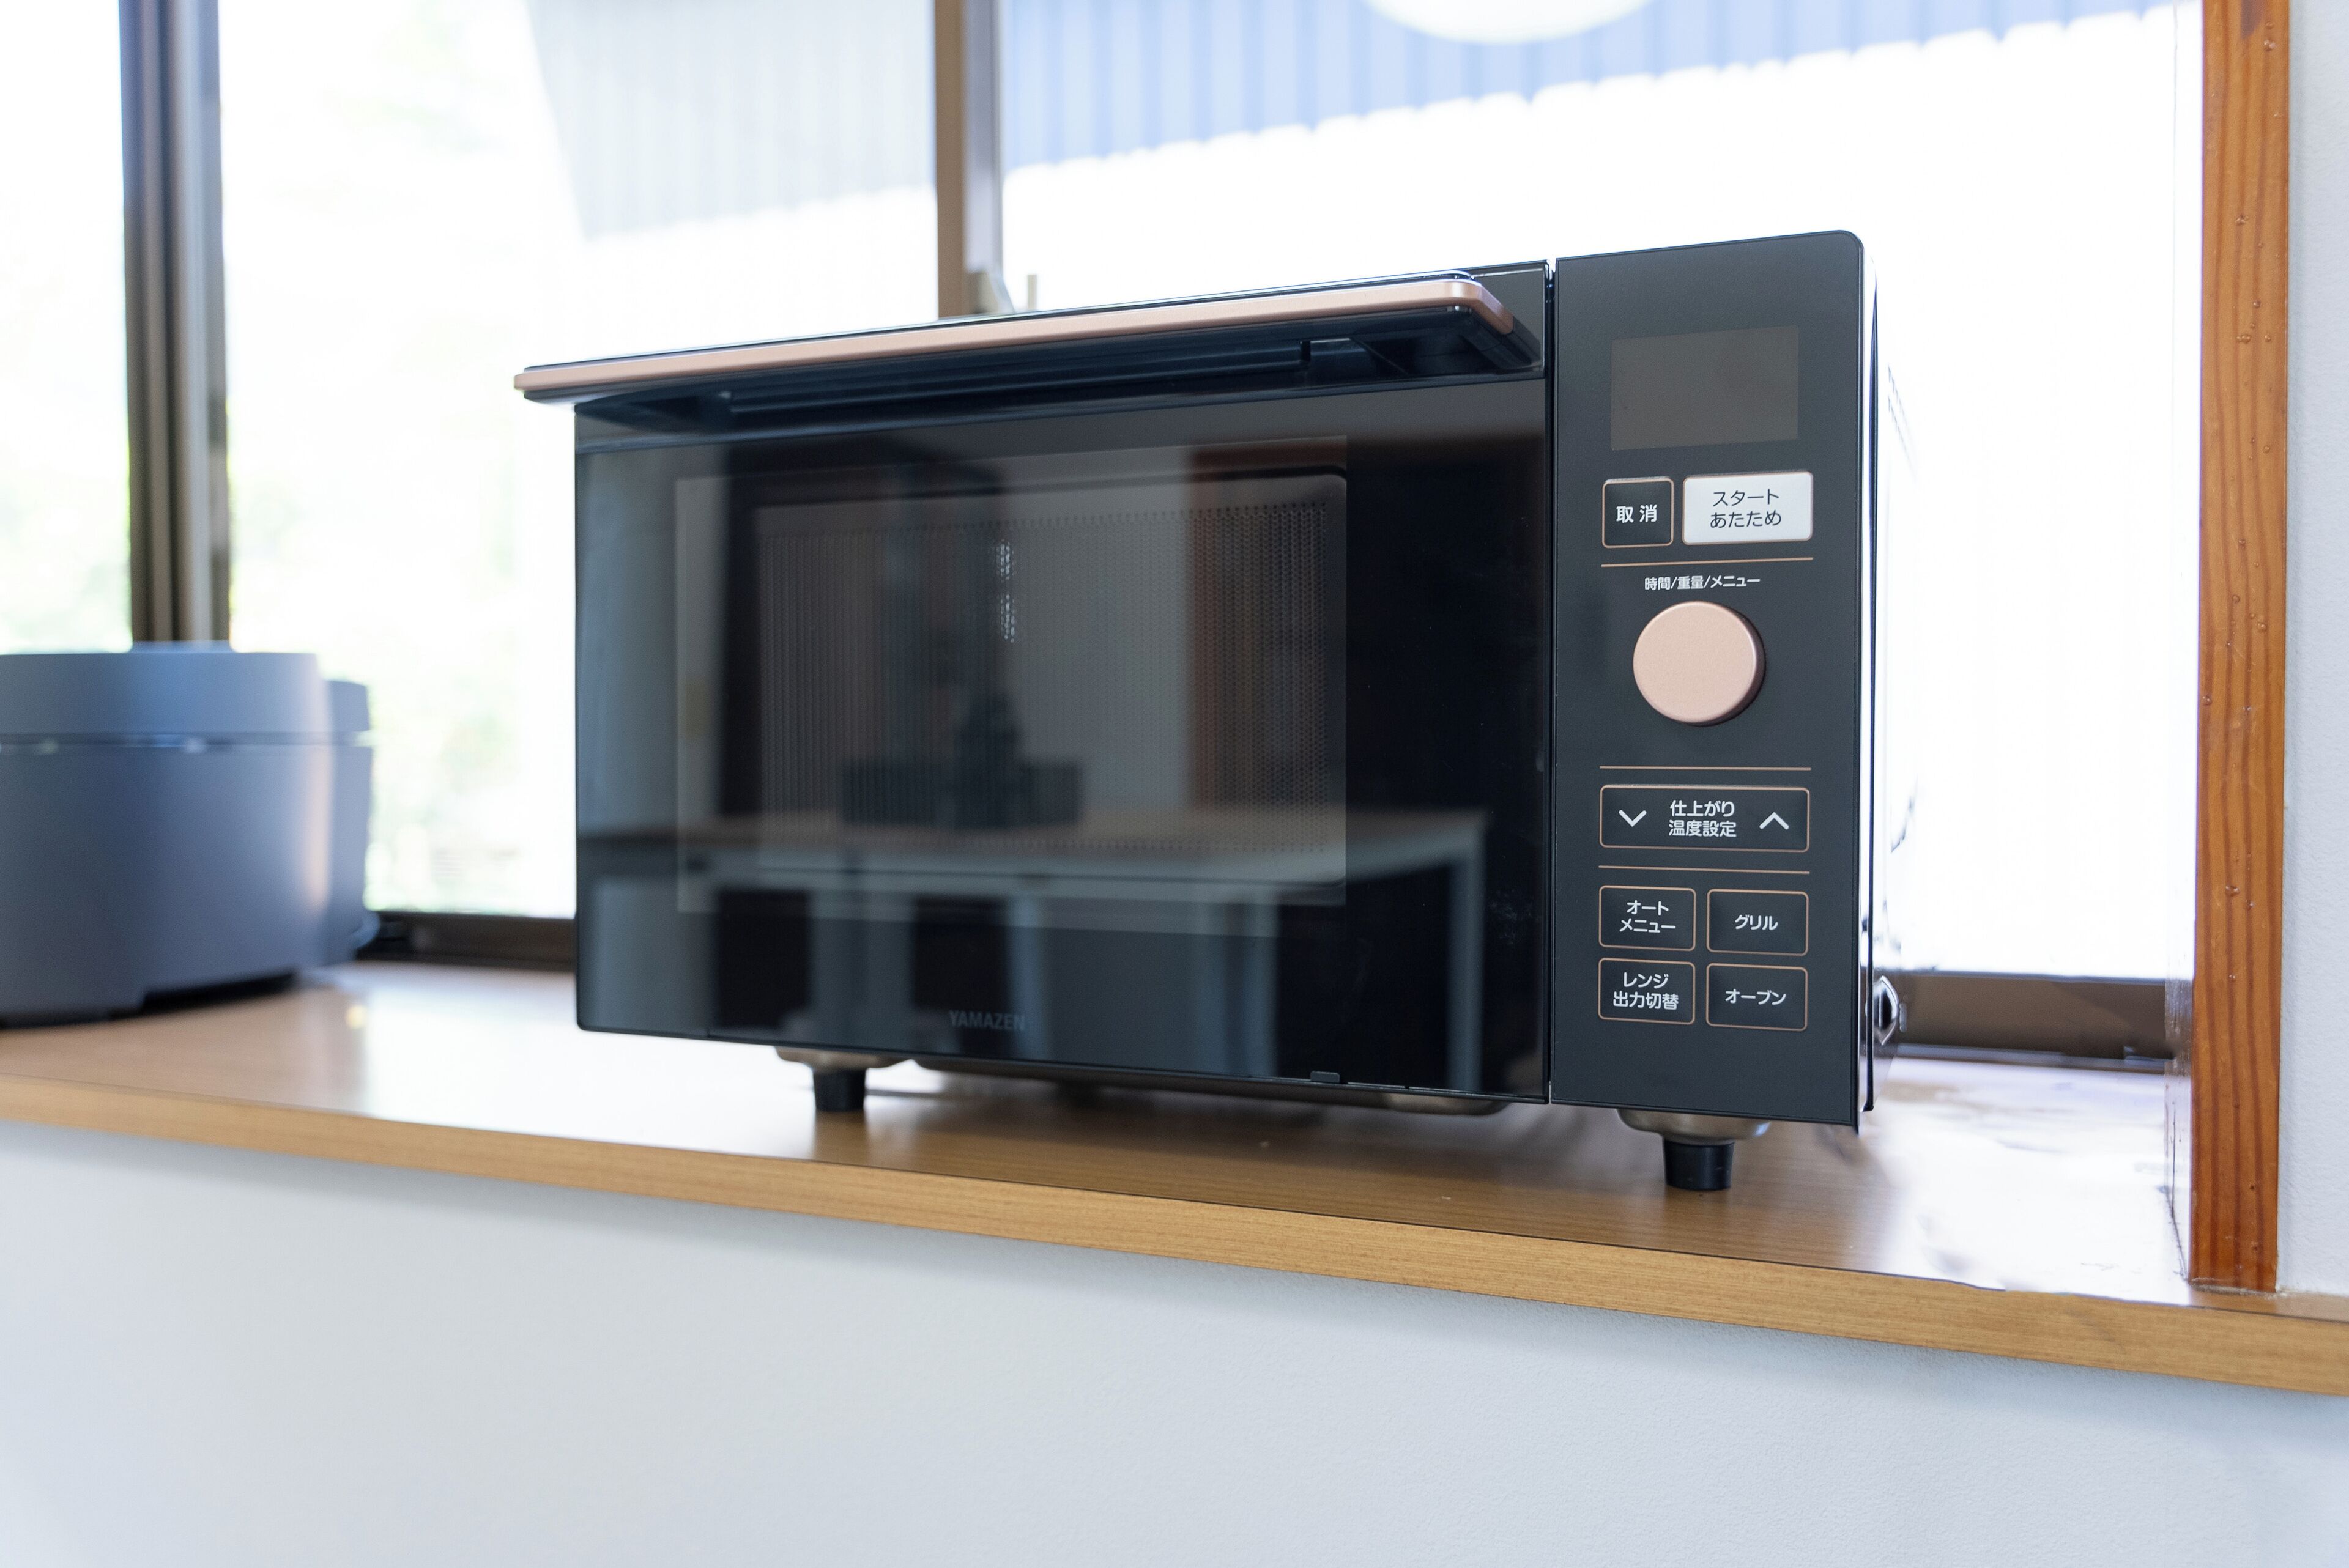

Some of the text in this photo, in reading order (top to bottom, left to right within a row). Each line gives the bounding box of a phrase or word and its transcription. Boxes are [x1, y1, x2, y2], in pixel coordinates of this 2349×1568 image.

[1712, 489, 1779, 508] スタート
[1616, 504, 1658, 524] 取消
[1709, 510, 1782, 529] あたため
[1644, 575, 1761, 591] 時間/重量/メニュー
[1669, 799, 1735, 818] 仕上がり
[1668, 819, 1737, 838] 温度設定
[1626, 900, 1669, 916] オート
[1619, 917, 1676, 933] メニュー
[1734, 914, 1779, 931] グリル
[1623, 971, 1669, 989] レンジ
[1612, 990, 1679, 1011] 出力切替
[1724, 988, 1787, 1006] オーブン
[949, 1009, 1025, 1032] YAMAZEN
